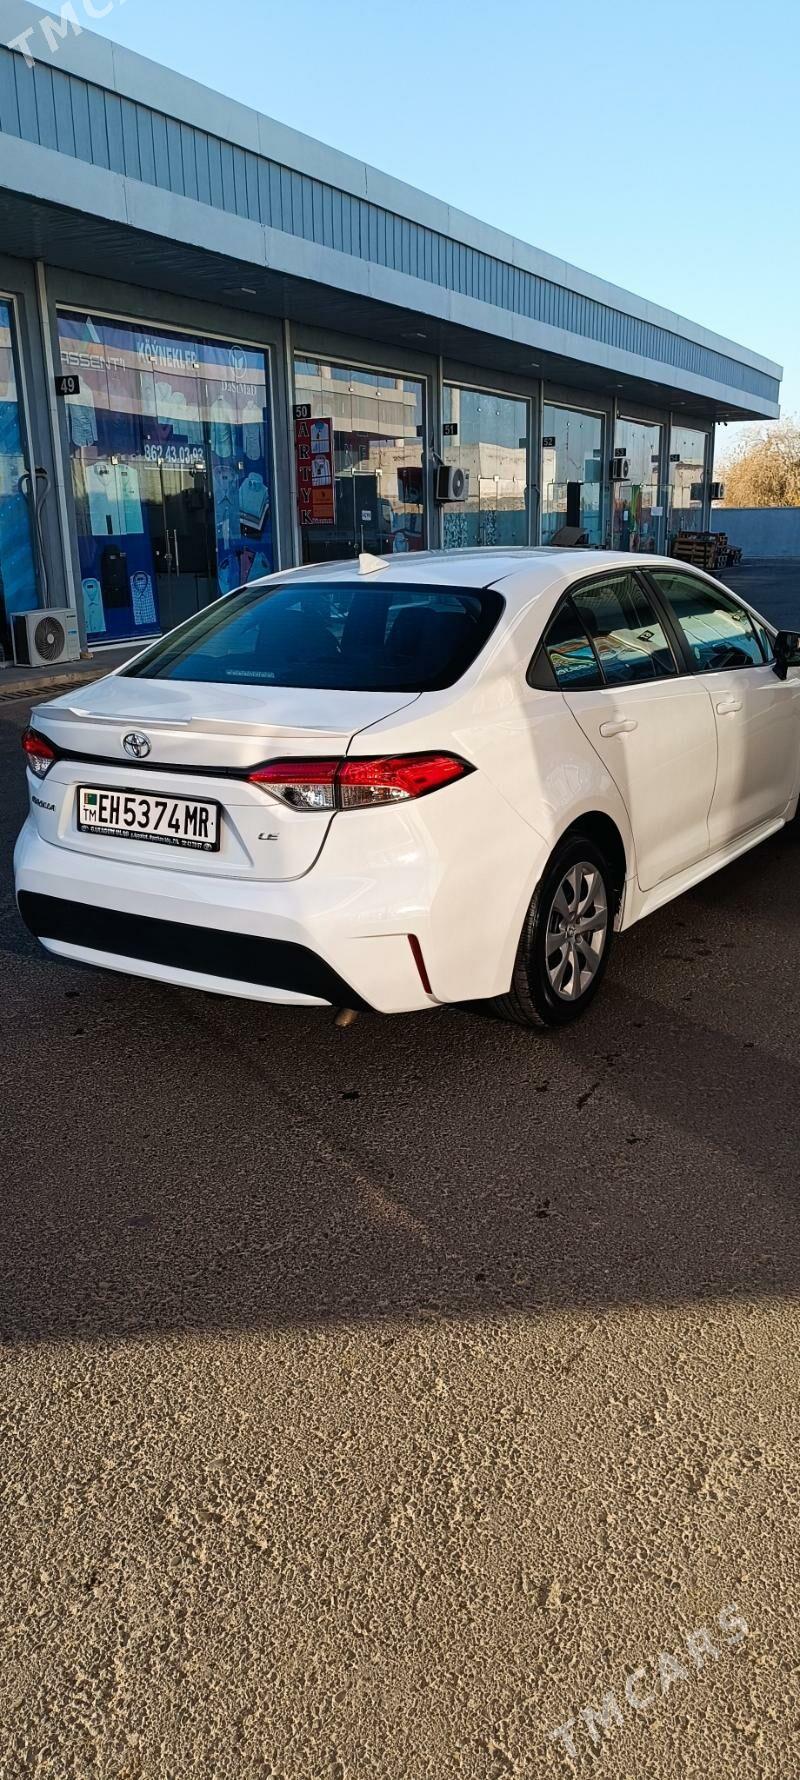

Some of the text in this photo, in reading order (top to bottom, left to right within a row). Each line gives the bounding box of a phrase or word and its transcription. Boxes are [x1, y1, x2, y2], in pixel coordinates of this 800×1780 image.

[61, 378, 75, 393] 49
[296, 406, 308, 418] 50
[445, 425, 454, 435] 51
[543, 437, 553, 446] 52
[298, 421, 313, 525] ARTYK
[83, 808, 97, 822] TM
[258, 832, 279, 841] LE
